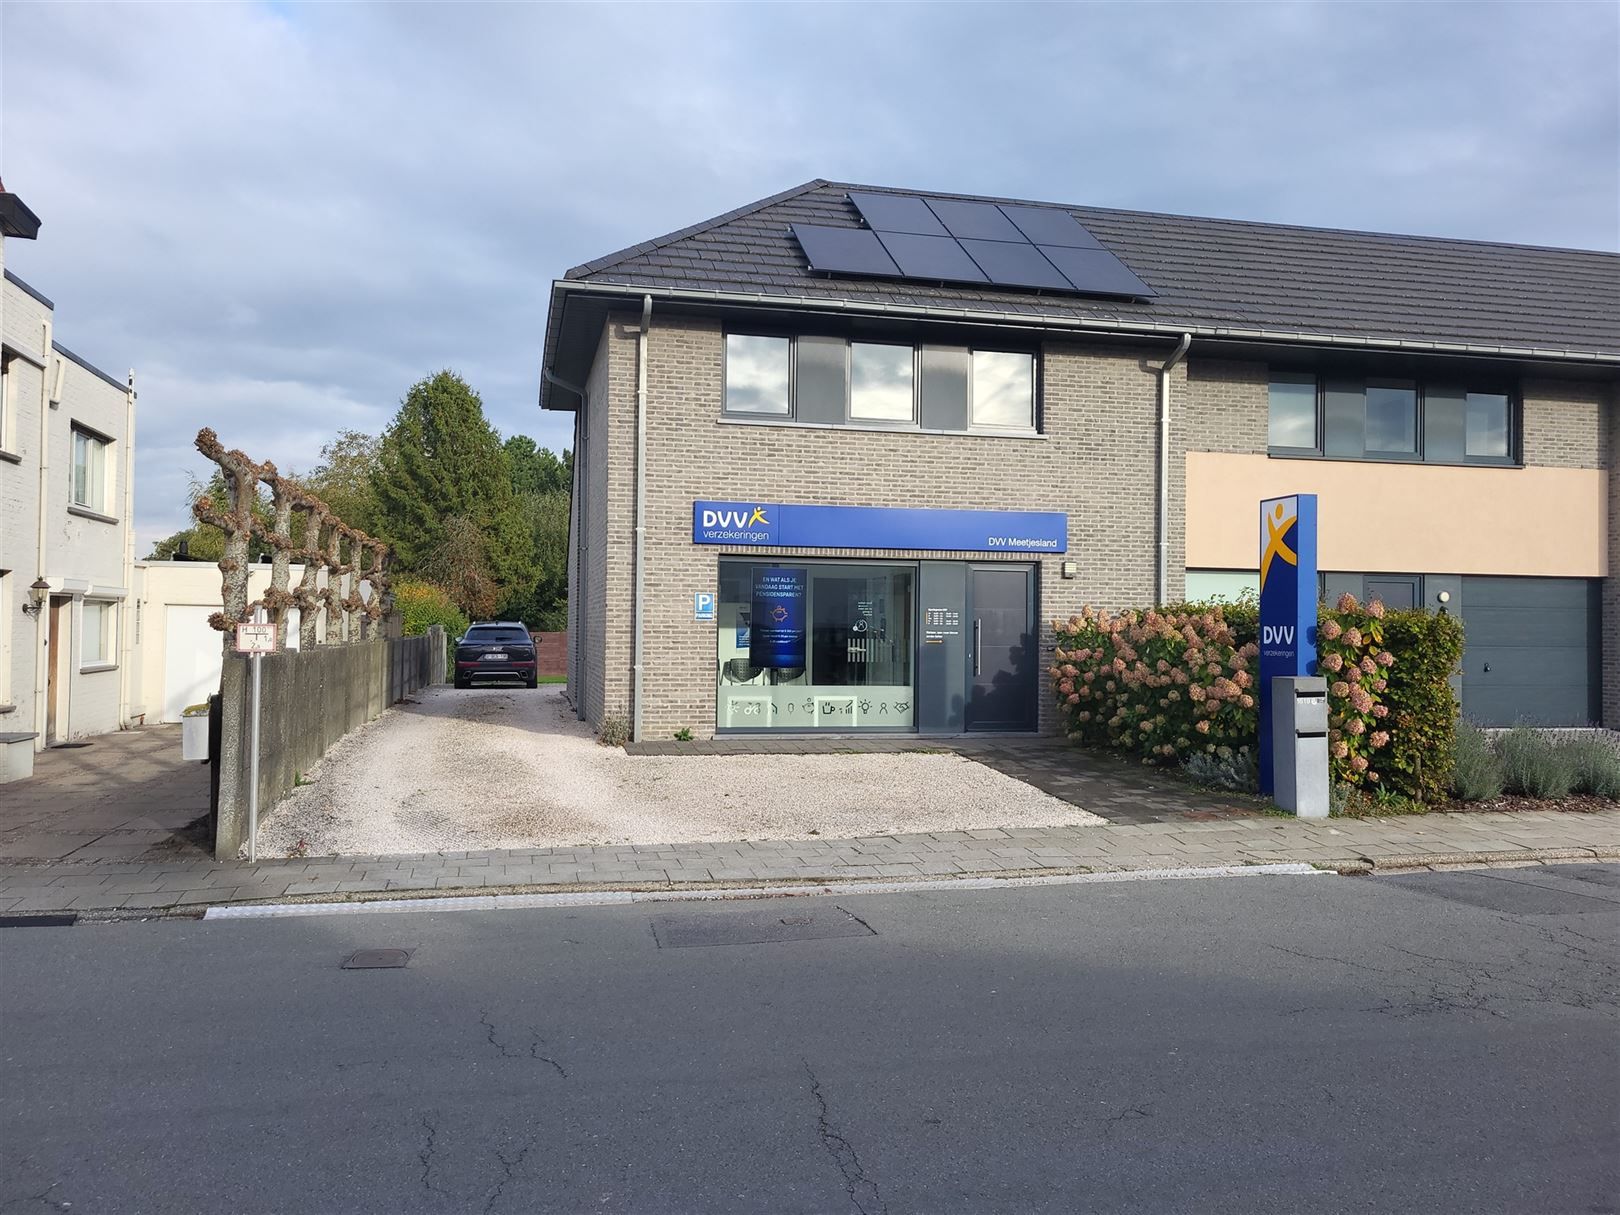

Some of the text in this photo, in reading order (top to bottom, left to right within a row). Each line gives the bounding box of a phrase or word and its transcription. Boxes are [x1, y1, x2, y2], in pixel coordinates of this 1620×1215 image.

[703, 510, 748, 528] DVV
[703, 530, 769, 541] verzekeringen
[988, 537, 1057, 548] DVV Meetjesland
[698, 594, 711, 611] P
[1263, 626, 1294, 644] DVV
[1263, 650, 1294, 658] verzekeringen
